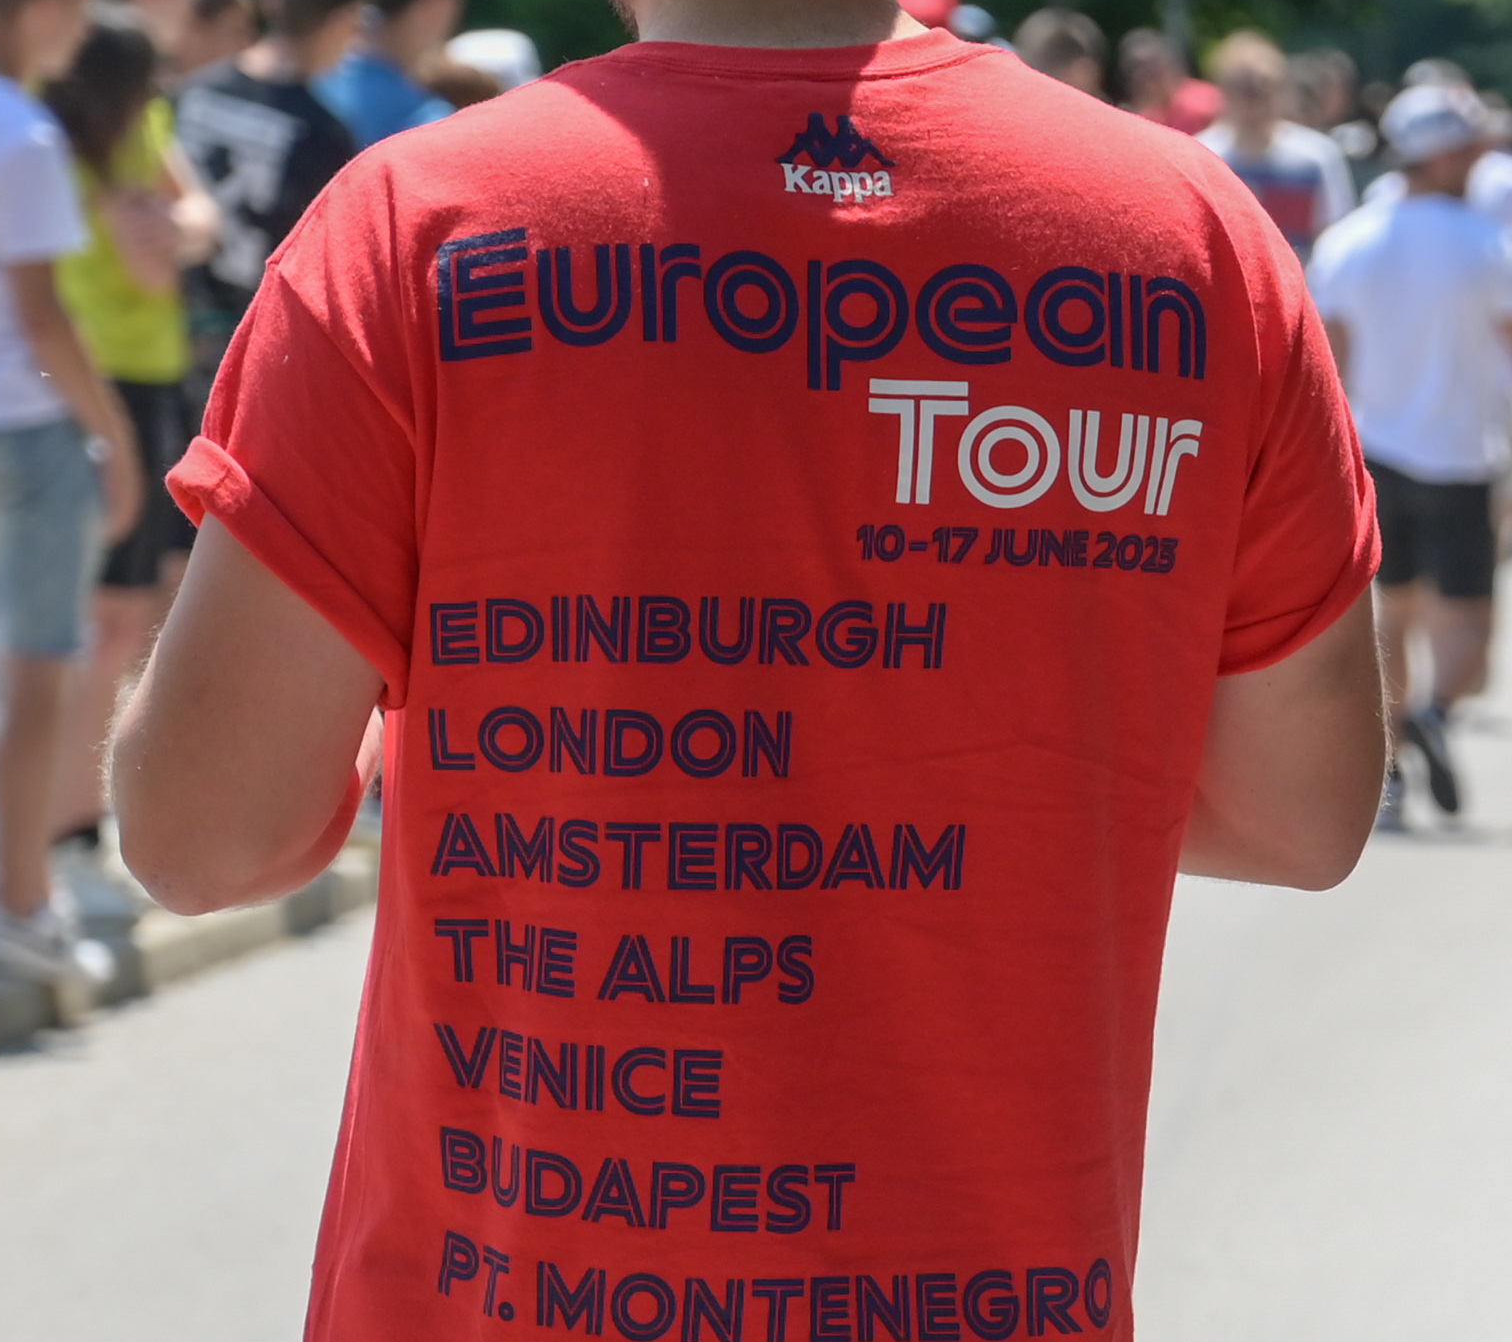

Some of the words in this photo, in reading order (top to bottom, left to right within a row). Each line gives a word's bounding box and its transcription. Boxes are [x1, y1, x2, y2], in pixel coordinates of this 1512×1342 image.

[781, 163, 894, 204] Kappa
[436, 227, 1209, 392] European
[868, 378, 1203, 516] Tour
[856, 523, 981, 565] 10-17
[984, 527, 1090, 568] JUNE
[429, 594, 947, 670] EDINBURGH
[427, 705, 793, 780] LONDON
[430, 812, 967, 892] AMSTERDAM
[434, 918, 579, 1000] THE
[597, 934, 816, 1006] ALPS
[433, 1023, 725, 1119] VENICE
[440, 1126, 857, 1233] BUDAPEST
[437, 1230, 516, 1323] PT.
